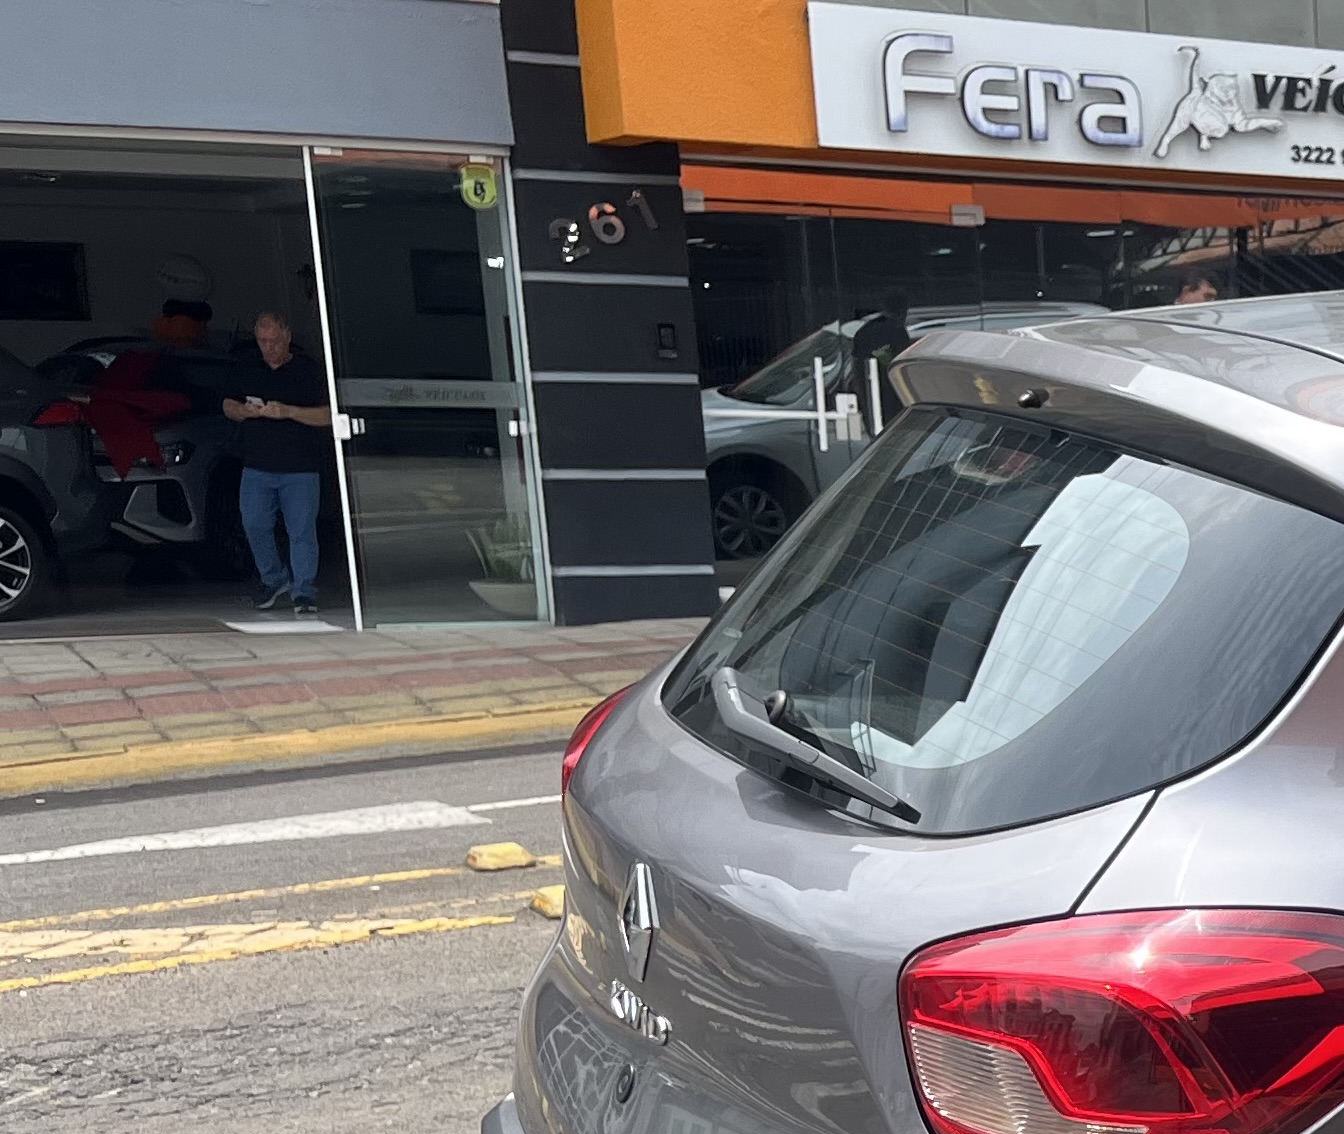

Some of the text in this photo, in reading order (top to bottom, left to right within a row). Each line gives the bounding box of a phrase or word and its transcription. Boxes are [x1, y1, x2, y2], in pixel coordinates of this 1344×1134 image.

[883, 31, 1143, 147] Fera
[1291, 145, 1335, 165] 3222
[548, 188, 659, 263] 261
